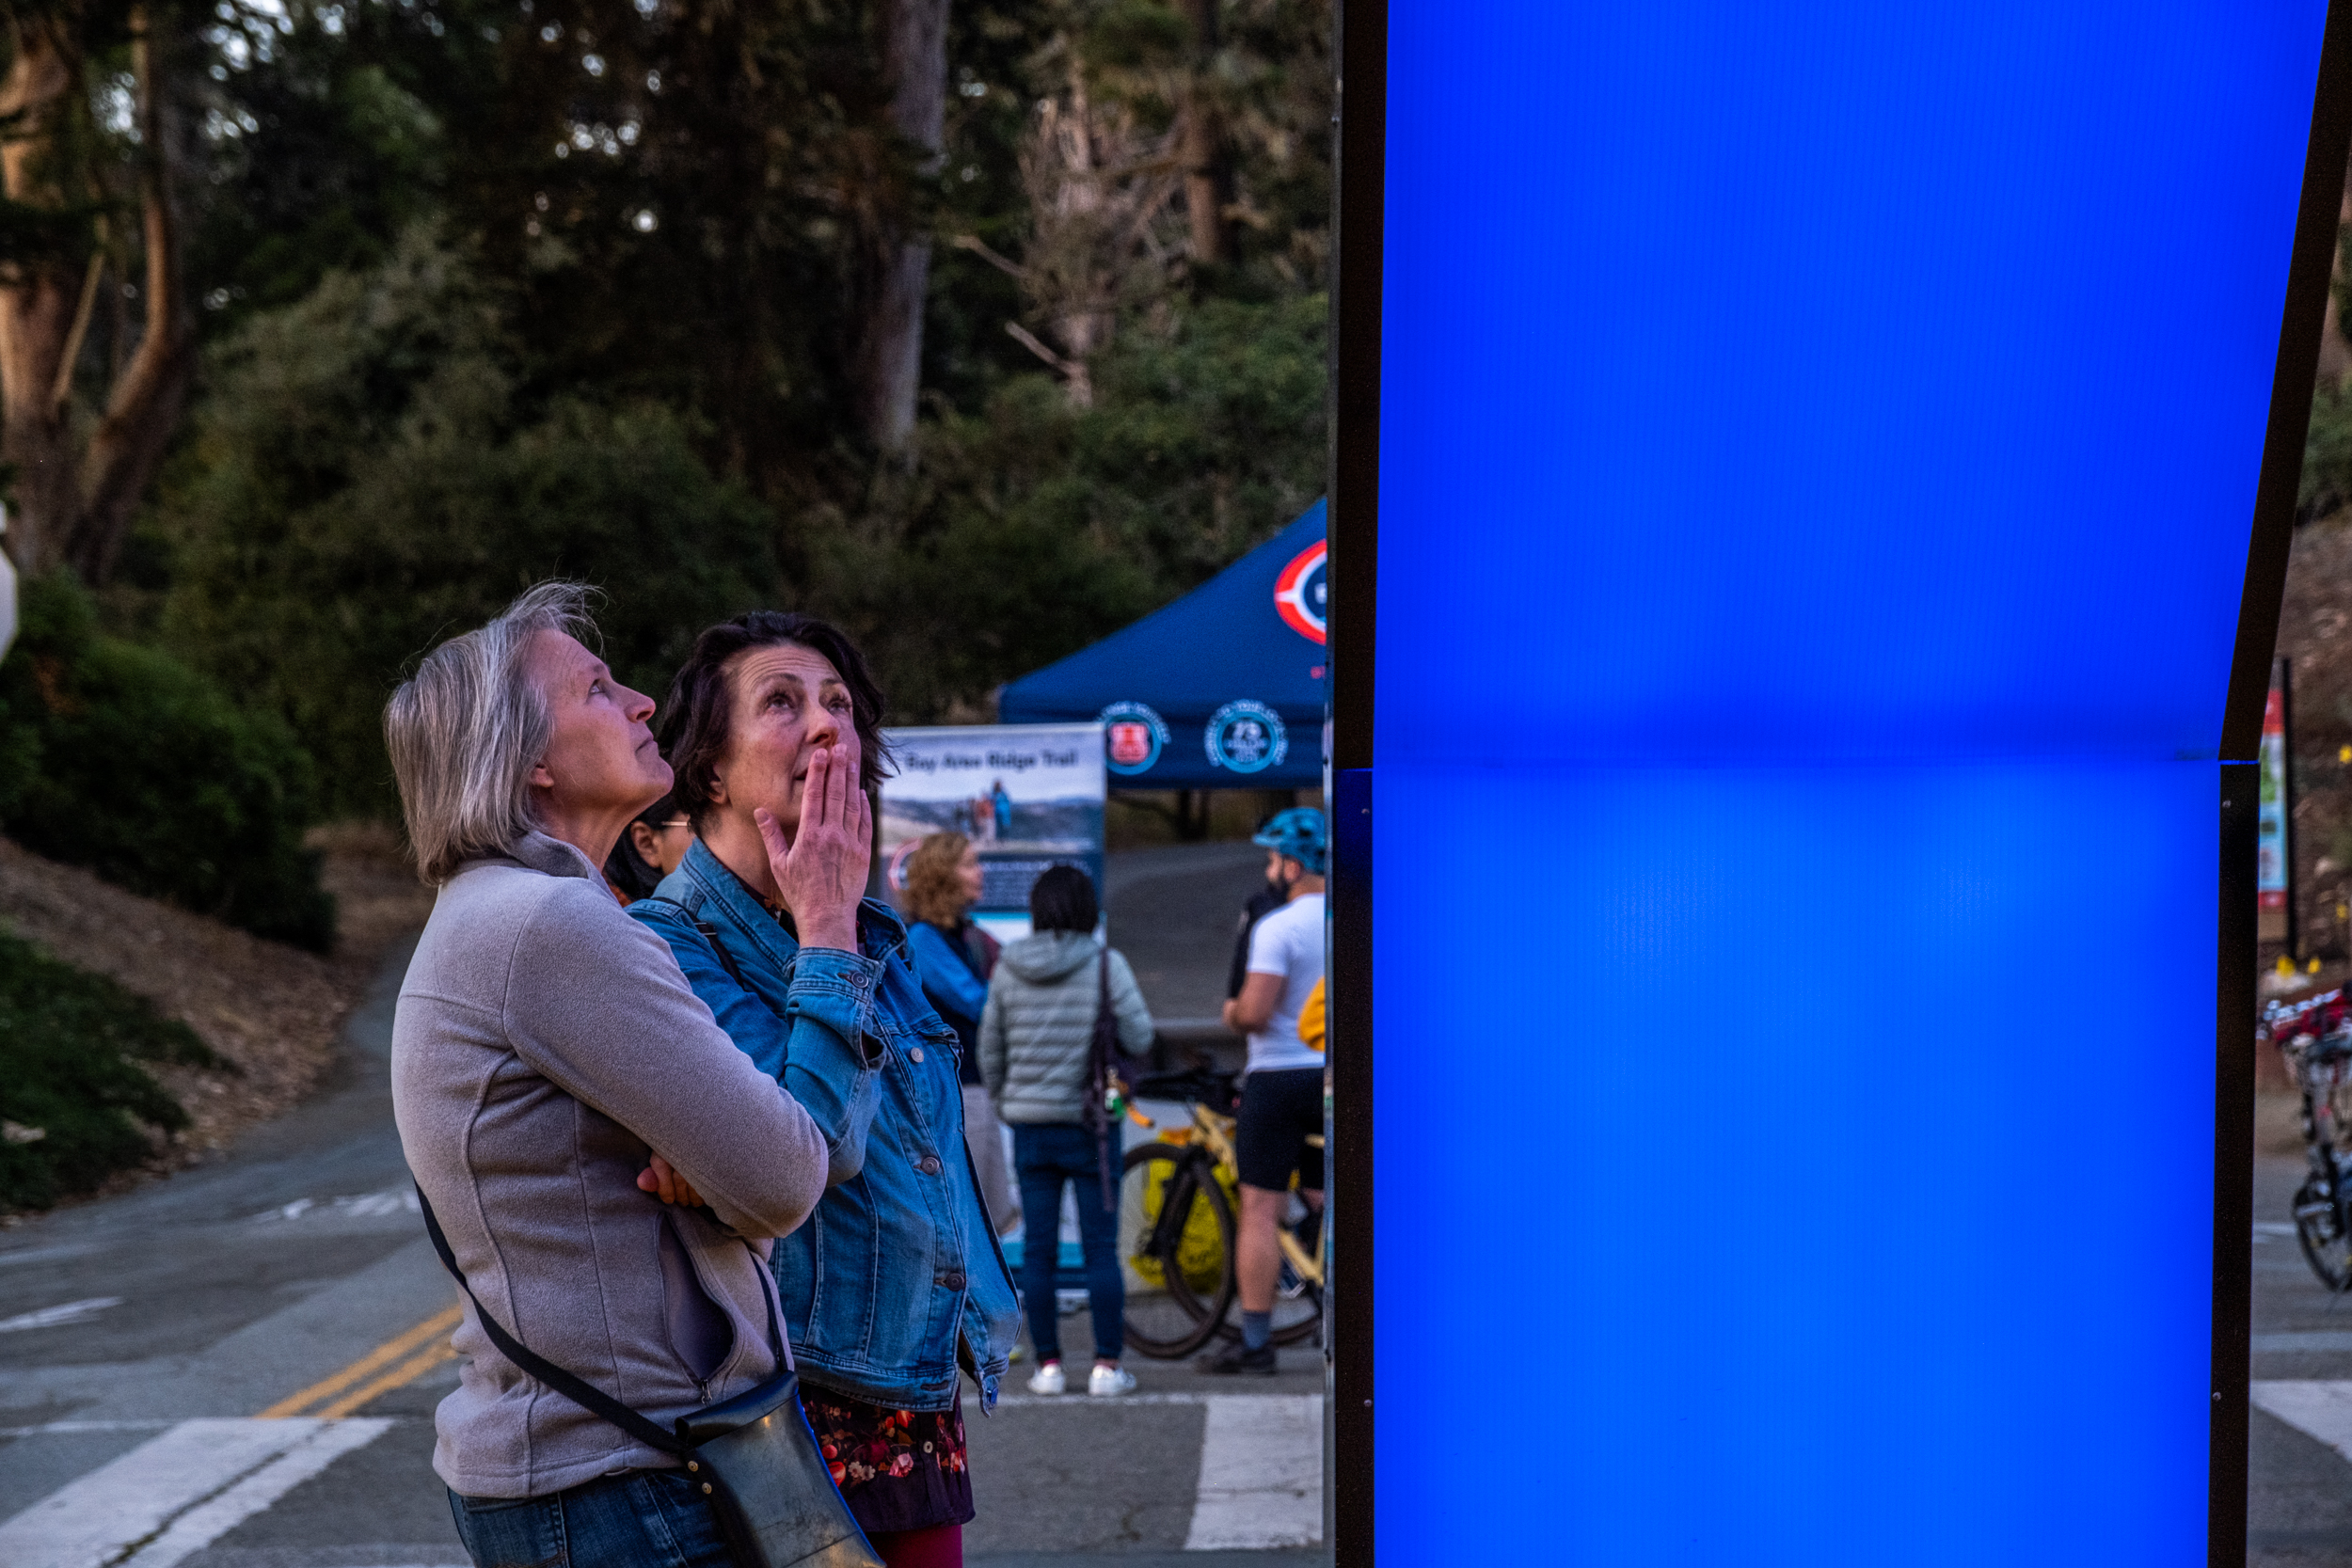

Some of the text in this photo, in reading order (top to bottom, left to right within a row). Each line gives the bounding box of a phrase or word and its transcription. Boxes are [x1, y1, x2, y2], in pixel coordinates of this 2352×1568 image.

[906, 749, 1077, 774] Bay Area Ridge Trail
